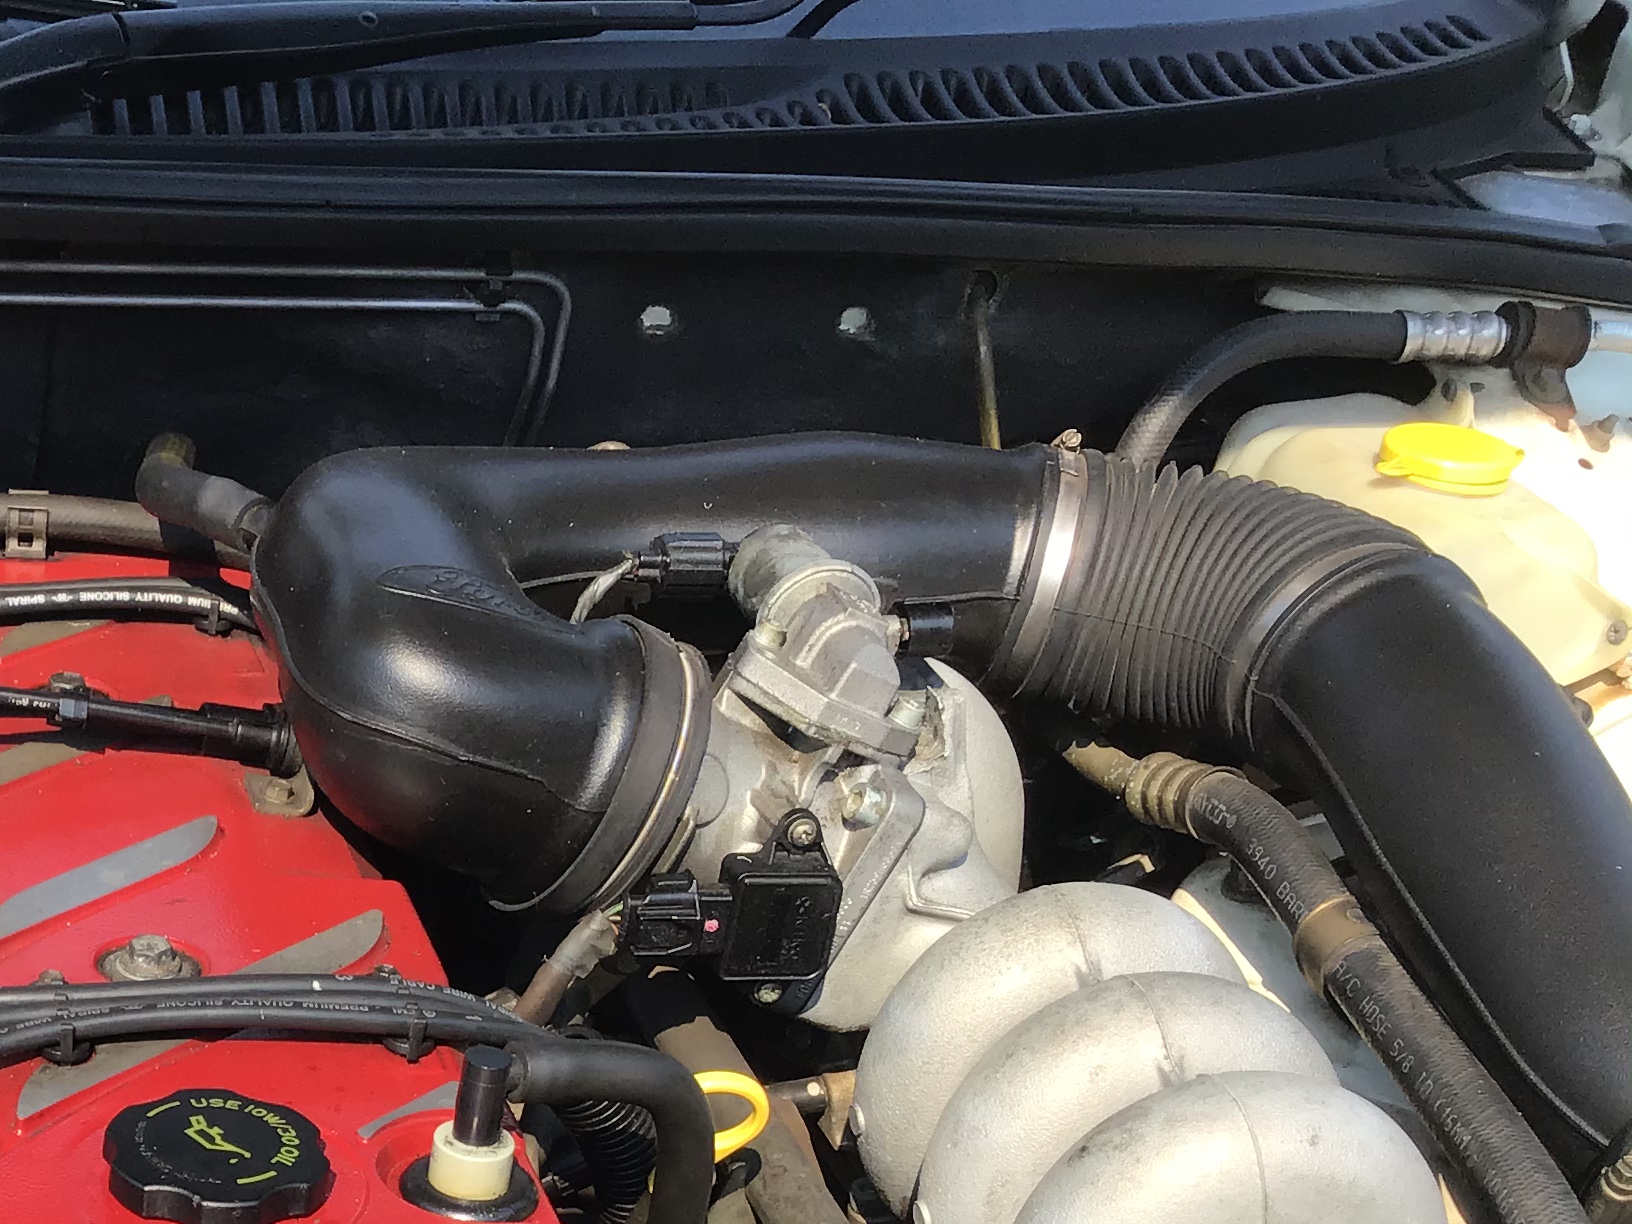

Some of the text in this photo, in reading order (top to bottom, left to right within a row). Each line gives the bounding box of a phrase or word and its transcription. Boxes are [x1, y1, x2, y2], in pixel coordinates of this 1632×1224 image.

[5, 594, 46, 607] SPIRAL
[79, 590, 130, 602] SILICONE
[134, 590, 183, 605] QUALITY
[1332, 960, 1362, 998] A/C
[1358, 995, 1393, 1041] HOSE
[190, 1097, 301, 1167] USE 10W/30 OIL
